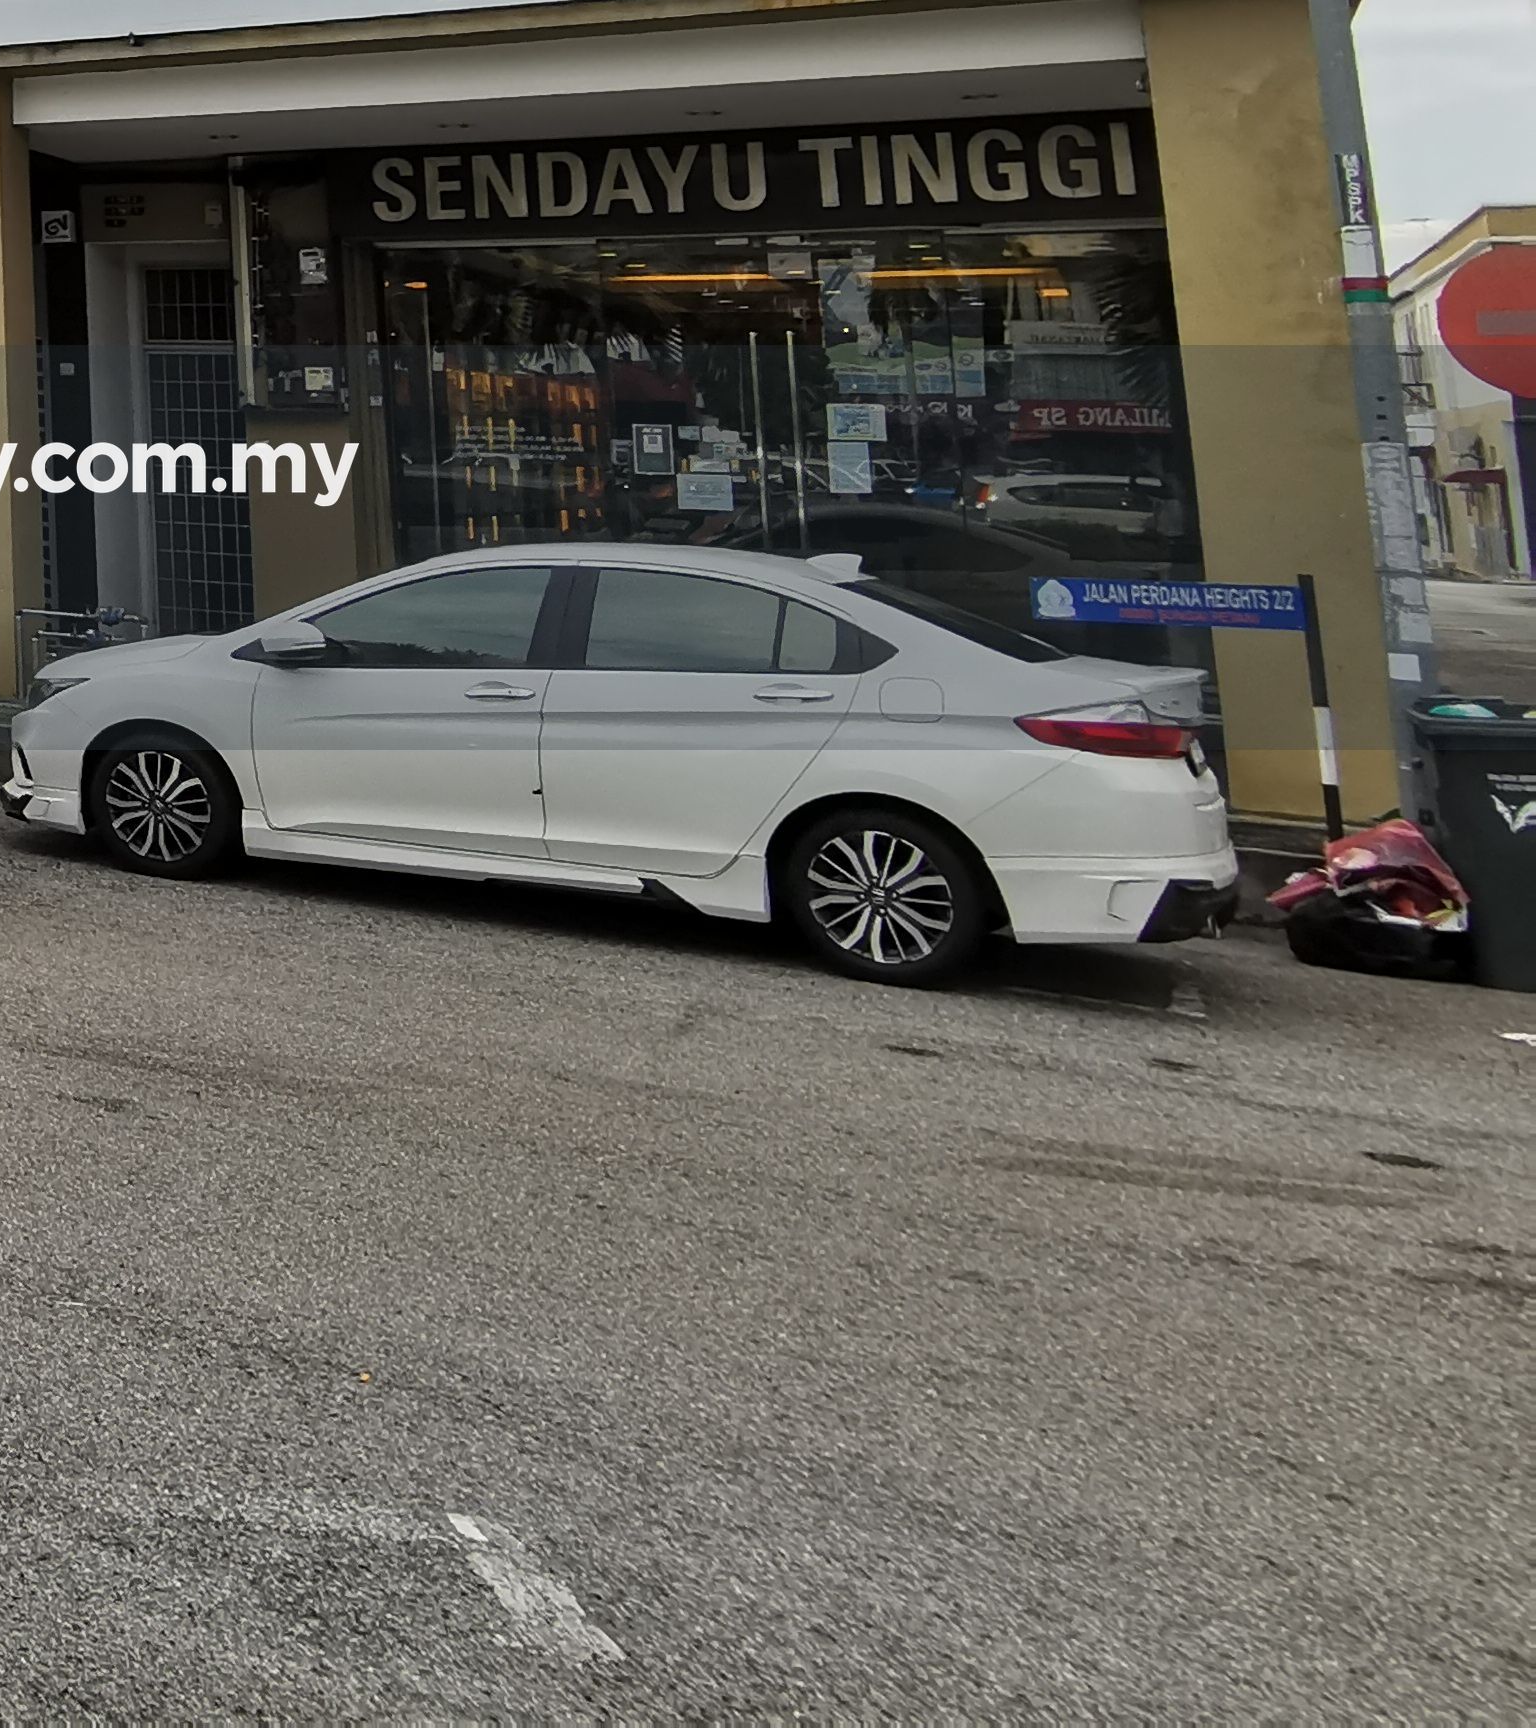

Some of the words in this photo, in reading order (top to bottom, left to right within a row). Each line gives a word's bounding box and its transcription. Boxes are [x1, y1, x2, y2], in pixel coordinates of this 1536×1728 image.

[372, 143, 766, 223] SENDAYU
[799, 123, 1137, 210] TINGGI
[1083, 583, 1128, 604] JALAN
[1131, 584, 1202, 608] PERDANA
[1205, 587, 1270, 610] HEIGHTS
[1273, 589, 1296, 611] 2/2
